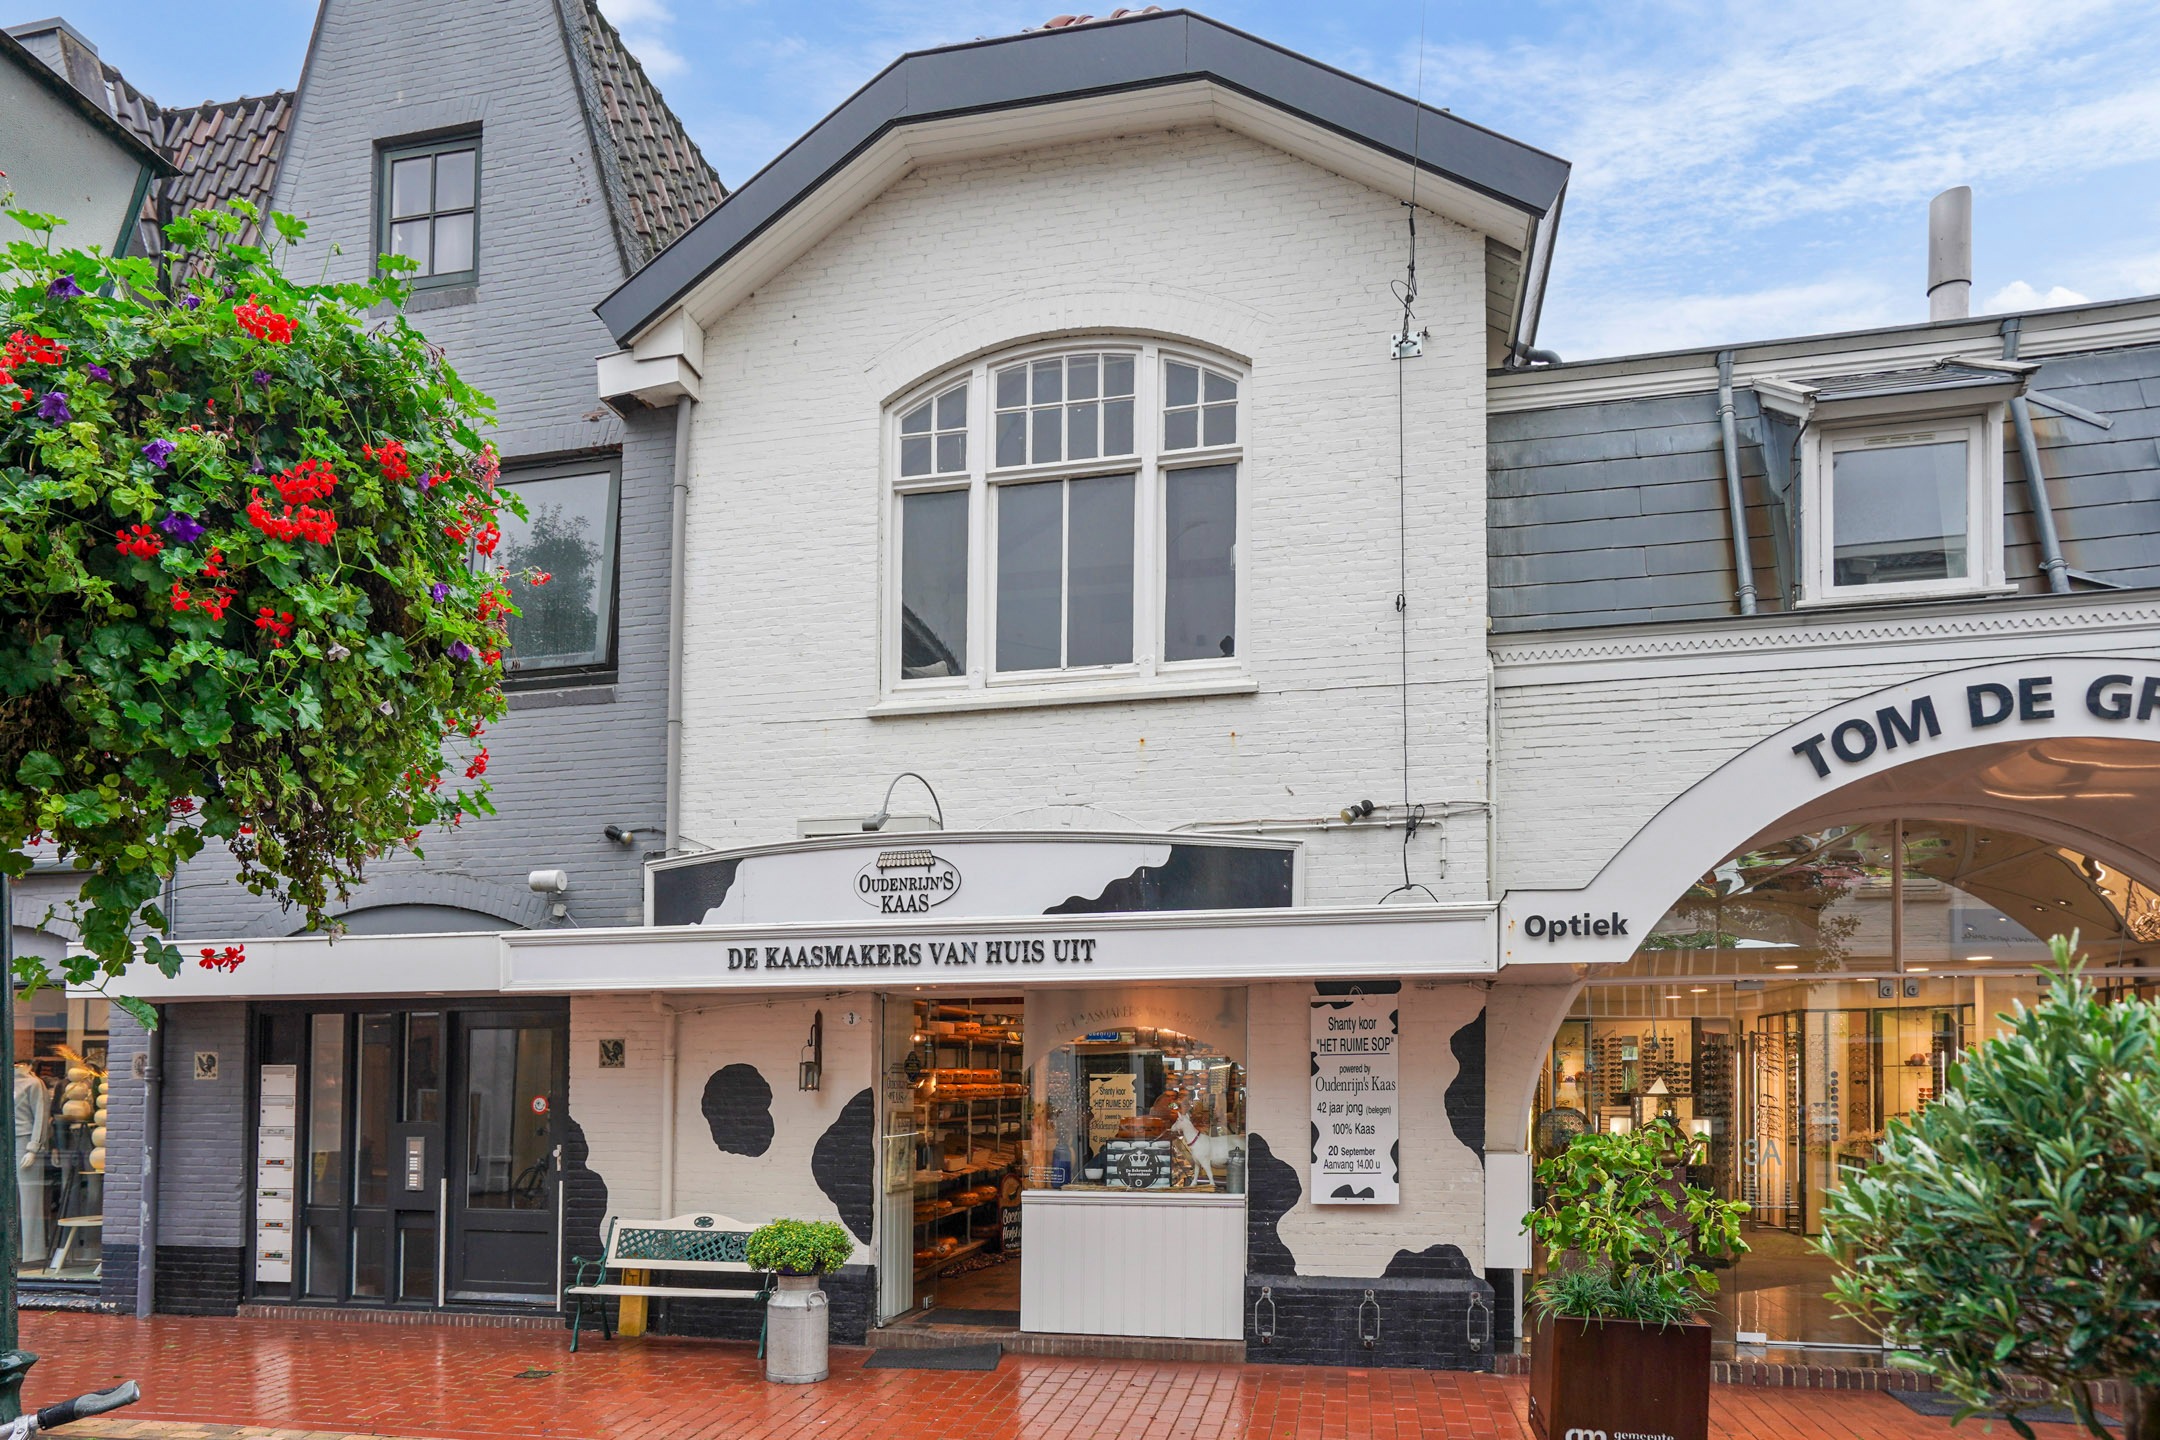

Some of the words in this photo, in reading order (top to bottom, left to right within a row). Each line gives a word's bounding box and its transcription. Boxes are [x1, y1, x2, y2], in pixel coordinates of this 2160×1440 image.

[1791, 695, 1942, 778] TOM
[1966, 676, 2055, 728] DE
[880, 893, 929, 914] KAAS
[1524, 911, 1629, 942] Optiek
[727, 947, 758, 970] DE
[764, 943, 922, 969] KAASMAKERS
[928, 942, 978, 965] VAN
[985, 940, 1045, 964] HUIS
[1052, 938, 1096, 962] UIT
[849, 1012, 854, 1024] 3
[1328, 1016, 1357, 1034] Shanty
[1358, 1016, 1377, 1030] koor
[1316, 1038, 1338, 1052] "HET
[1340, 1037, 1369, 1052] RUIME
[1371, 1036, 1394, 1051] SOP"
[1339, 1064, 1363, 1075] powered
[1364, 1064, 1371, 1075] by
[1099, 1087, 1115, 1097] Shanty
[1315, 1076, 1369, 1096] Oudenrijn's
[1371, 1076, 1396, 1092] Kaas
[1317, 1102, 1327, 1114] 42
[1328, 1102, 1344, 1116] jaar
[1345, 1101, 1363, 1116] jong
[1365, 1105, 1391, 1117] (belegen)
[1332, 1123, 1353, 1135] 100%
[1354, 1122, 1376, 1135] Kaas
[1328, 1145, 1338, 1156] 20
[1340, 1146, 1376, 1157] September
[1743, 1138, 1783, 1166] 3A
[1323, 1159, 1354, 1172] Aanvang
[1356, 1159, 1374, 1169] 14.00
[1375, 1161, 1381, 1169] u
